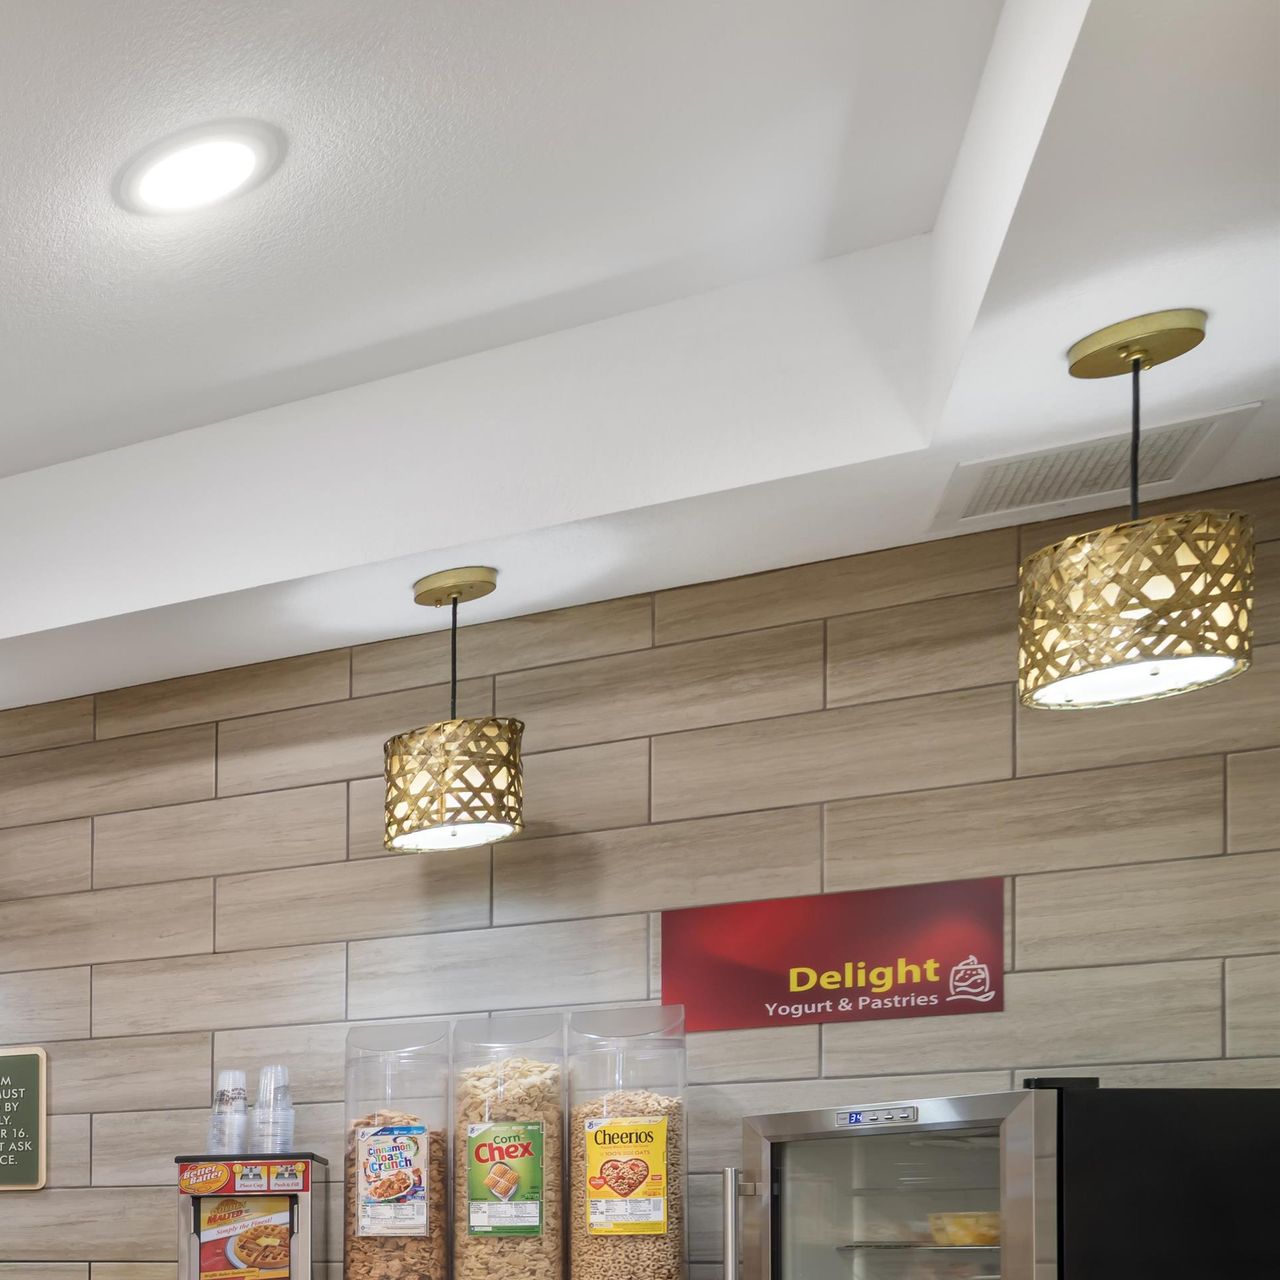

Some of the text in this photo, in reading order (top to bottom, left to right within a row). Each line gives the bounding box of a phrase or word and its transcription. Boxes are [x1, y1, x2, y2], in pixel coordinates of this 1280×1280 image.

[789, 958, 940, 993] Delight
[764, 992, 939, 1018] Yogurt & Pastries
[4, 1102, 19, 1112] BY
[12, 1128, 29, 1138] 16.
[493, 1134, 520, 1145] Corn
[594, 1130, 654, 1146] Cheerios
[8, 1141, 33, 1152] ASK
[368, 1142, 411, 1156] Cinnamon
[474, 1142, 534, 1164] Chex
[375, 1151, 405, 1162] Toast
[183, 1165, 218, 1180] Better
[371, 1157, 413, 1173] Crunch
[189, 1170, 223, 1185] Batter
[216, 1225, 239, 1236] Simply
[251, 1217, 273, 1227] Finest!
